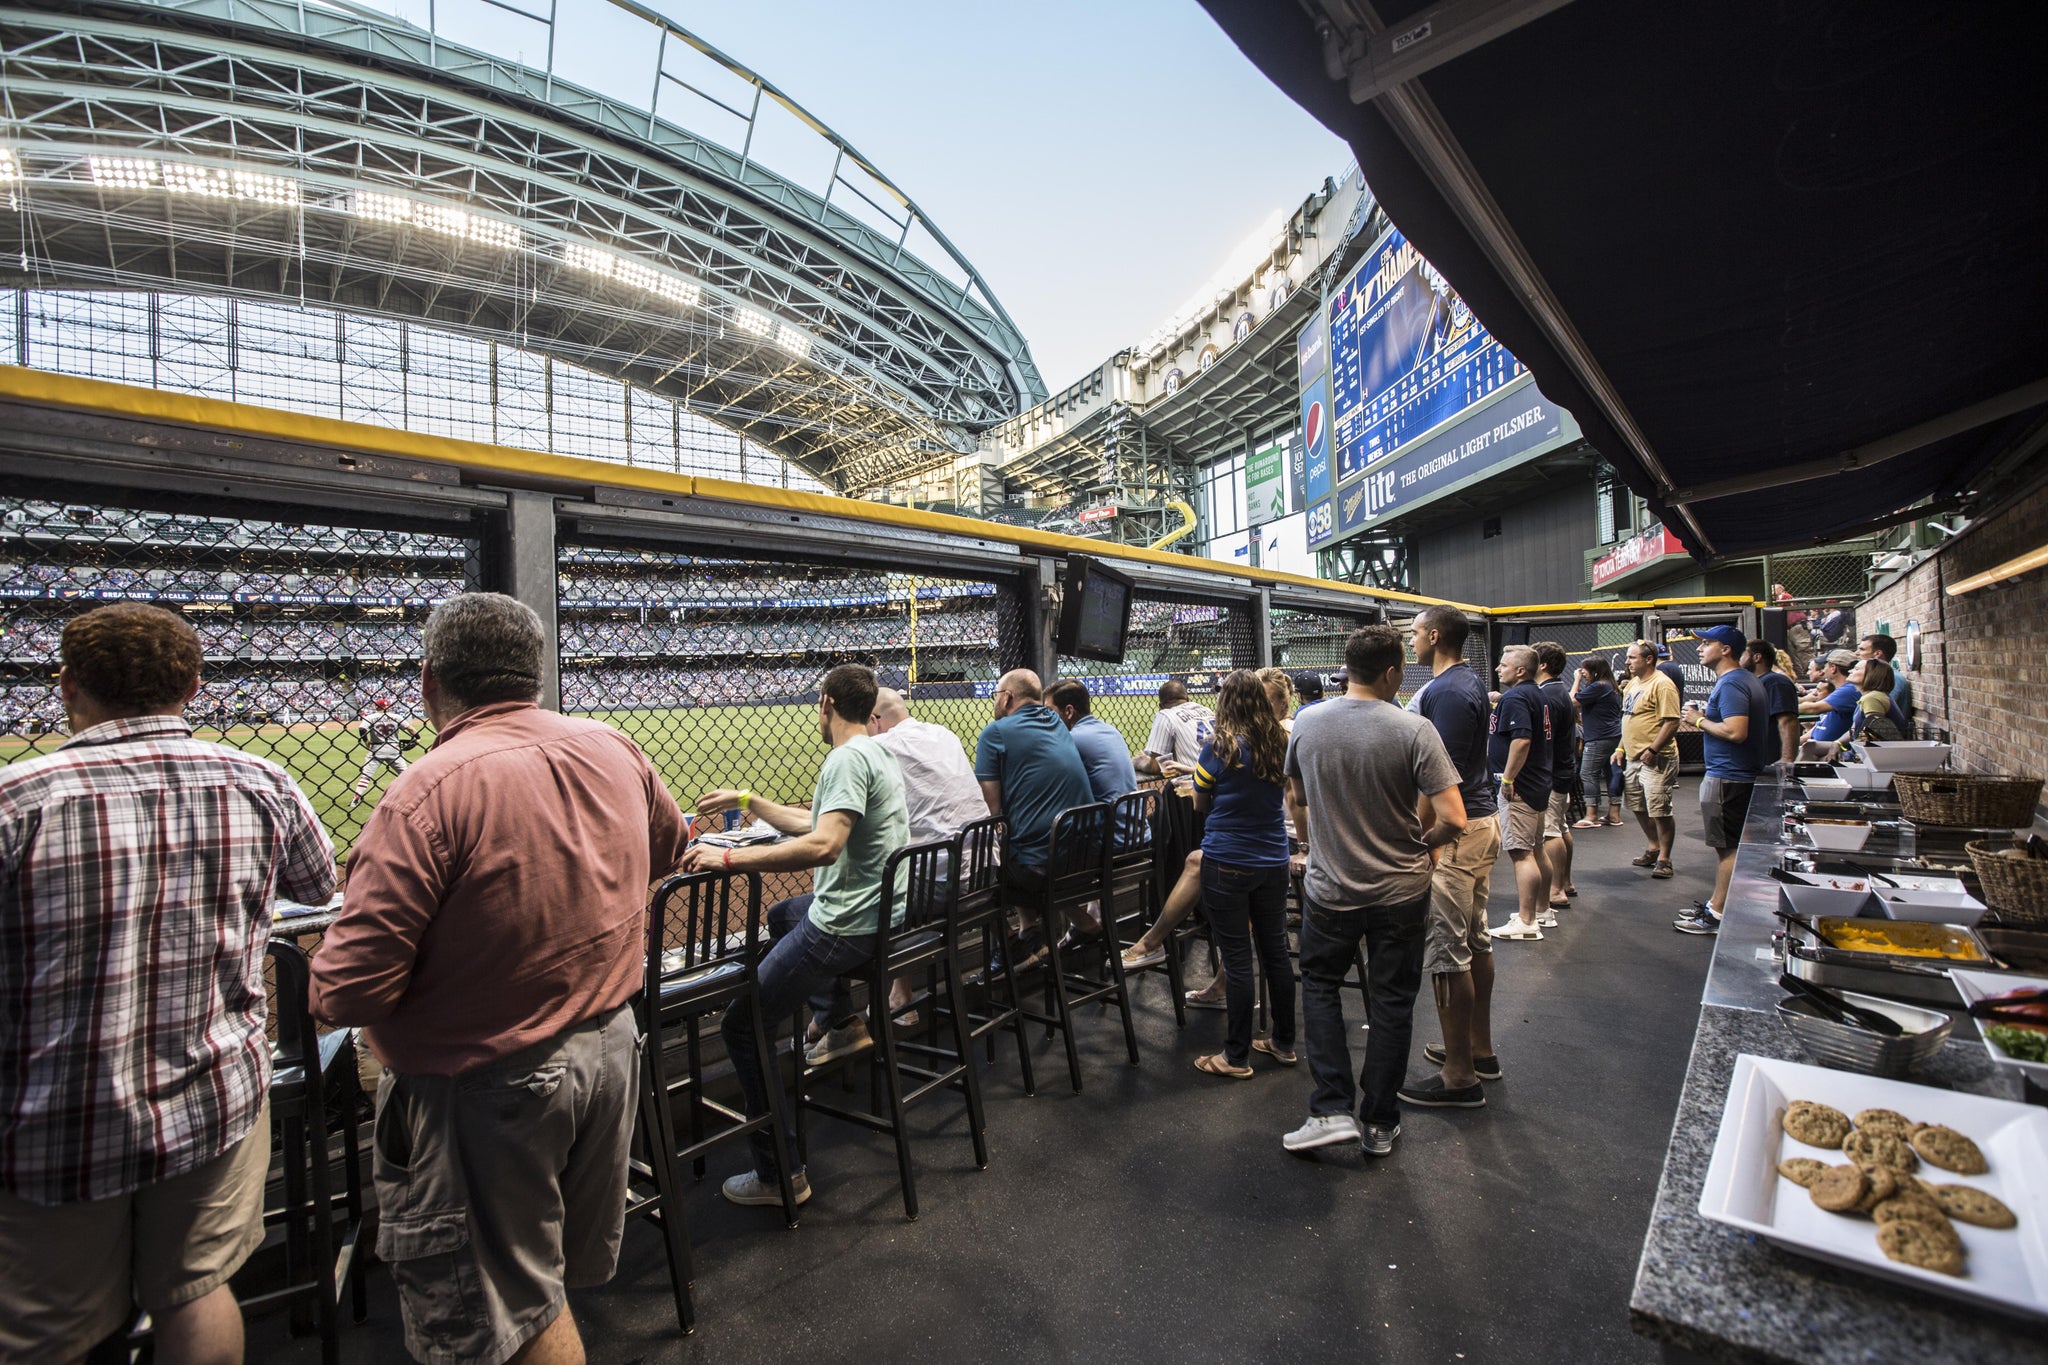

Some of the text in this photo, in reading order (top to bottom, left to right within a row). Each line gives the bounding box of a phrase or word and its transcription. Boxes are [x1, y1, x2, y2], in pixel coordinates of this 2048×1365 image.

[1400, 470, 1417, 489] THE
[1417, 450, 1459, 481] ORIGINAL
[1460, 432, 1491, 460] LIGHT
[1493, 405, 1546, 444] PILSNER.
[1246, 464, 1255, 474] THE
[1309, 458, 1327, 484] pepsi
[1317, 502, 1332, 534] 58
[1598, 558, 1616, 579] TOYOTA
